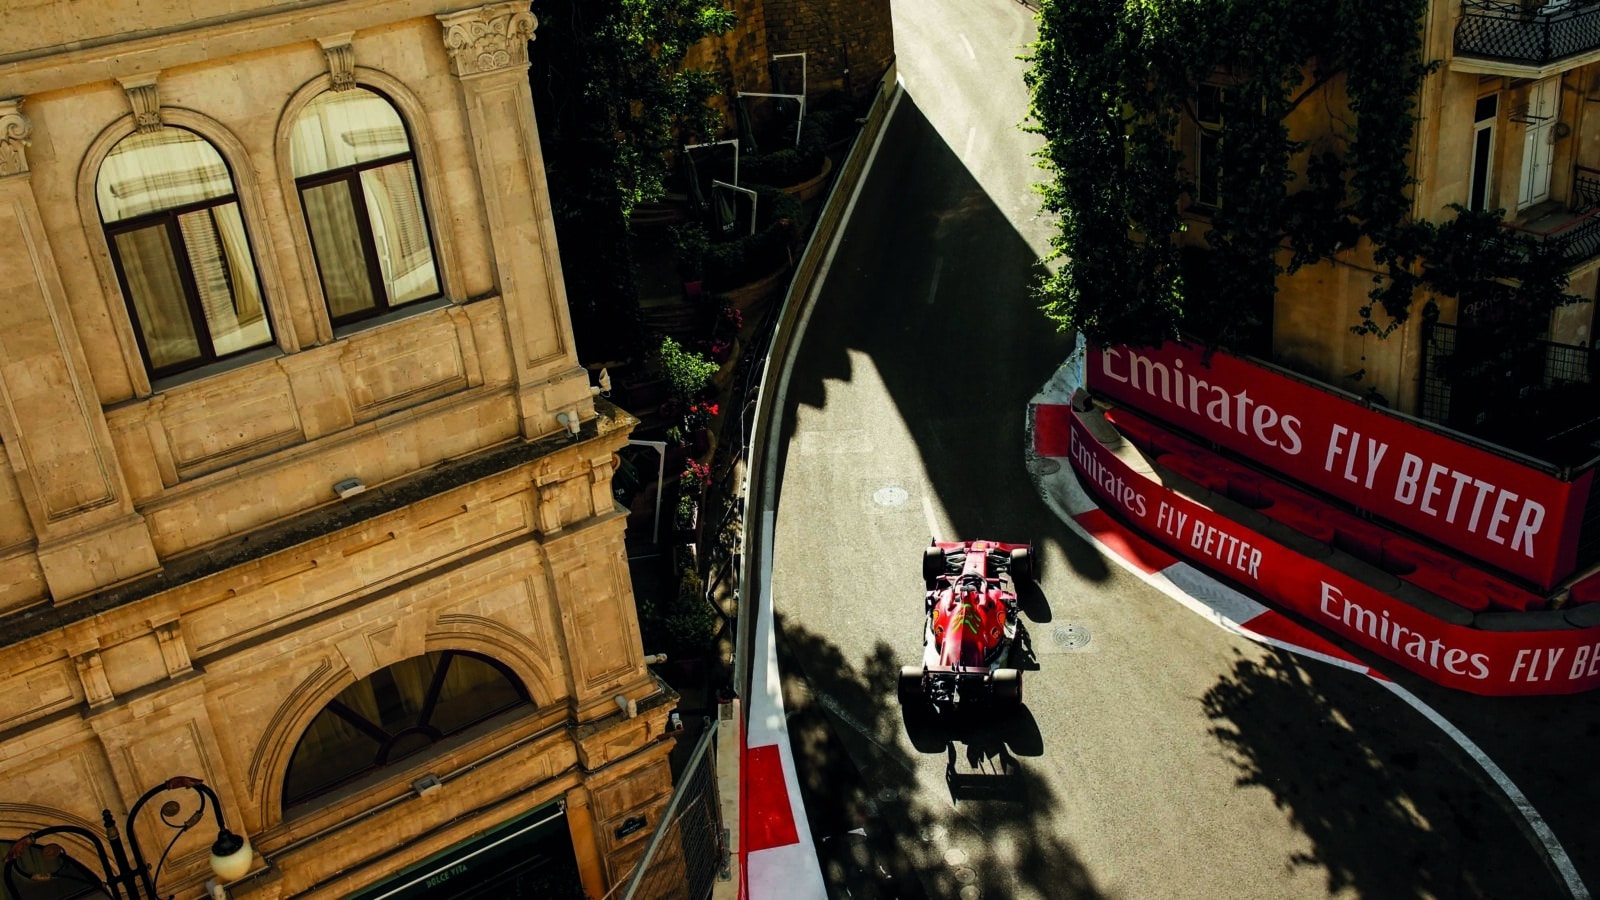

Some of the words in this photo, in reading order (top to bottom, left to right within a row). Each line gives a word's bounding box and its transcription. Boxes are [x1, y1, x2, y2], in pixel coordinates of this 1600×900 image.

[1070, 425, 1147, 518] Emirates
[1156, 501, 1188, 540] FLY
[1190, 519, 1263, 580] BETTER
[1102, 343, 1302, 455] Emirates
[1324, 423, 1389, 490] FLY
[1394, 451, 1546, 559] BETTER
[1320, 580, 1490, 680] Emirates
[1509, 647, 1565, 682] FLY
[1568, 642, 1600, 680] BE
[426, 871, 449, 888] DOLCE
[451, 864, 468, 875] VITA
